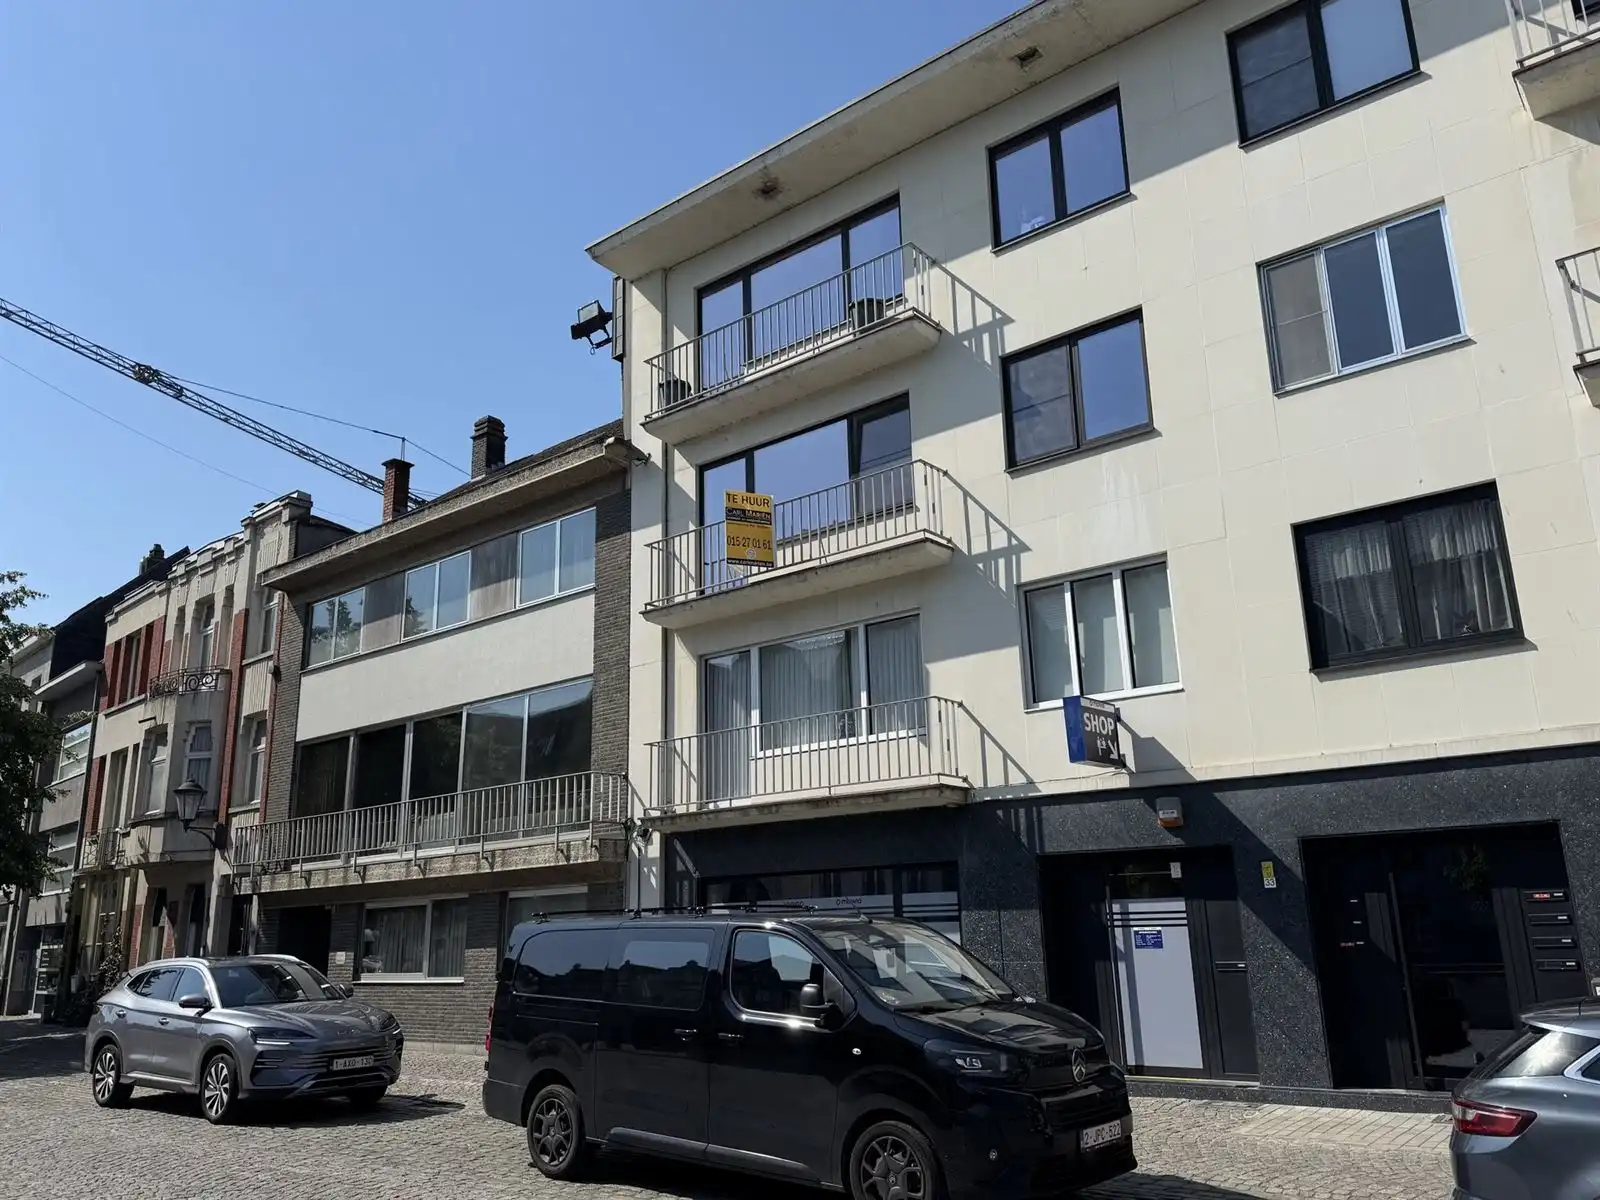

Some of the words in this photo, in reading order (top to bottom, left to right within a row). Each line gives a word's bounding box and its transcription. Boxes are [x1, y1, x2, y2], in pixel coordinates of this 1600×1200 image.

[727, 493, 738, 504] TE
[741, 495, 770, 508] HUUR
[727, 535, 740, 546] 015
[741, 536, 751, 548] 27
[752, 537, 761, 549] 01
[1083, 712, 1115, 736] SHOP
[1265, 878, 1275, 886] 33
